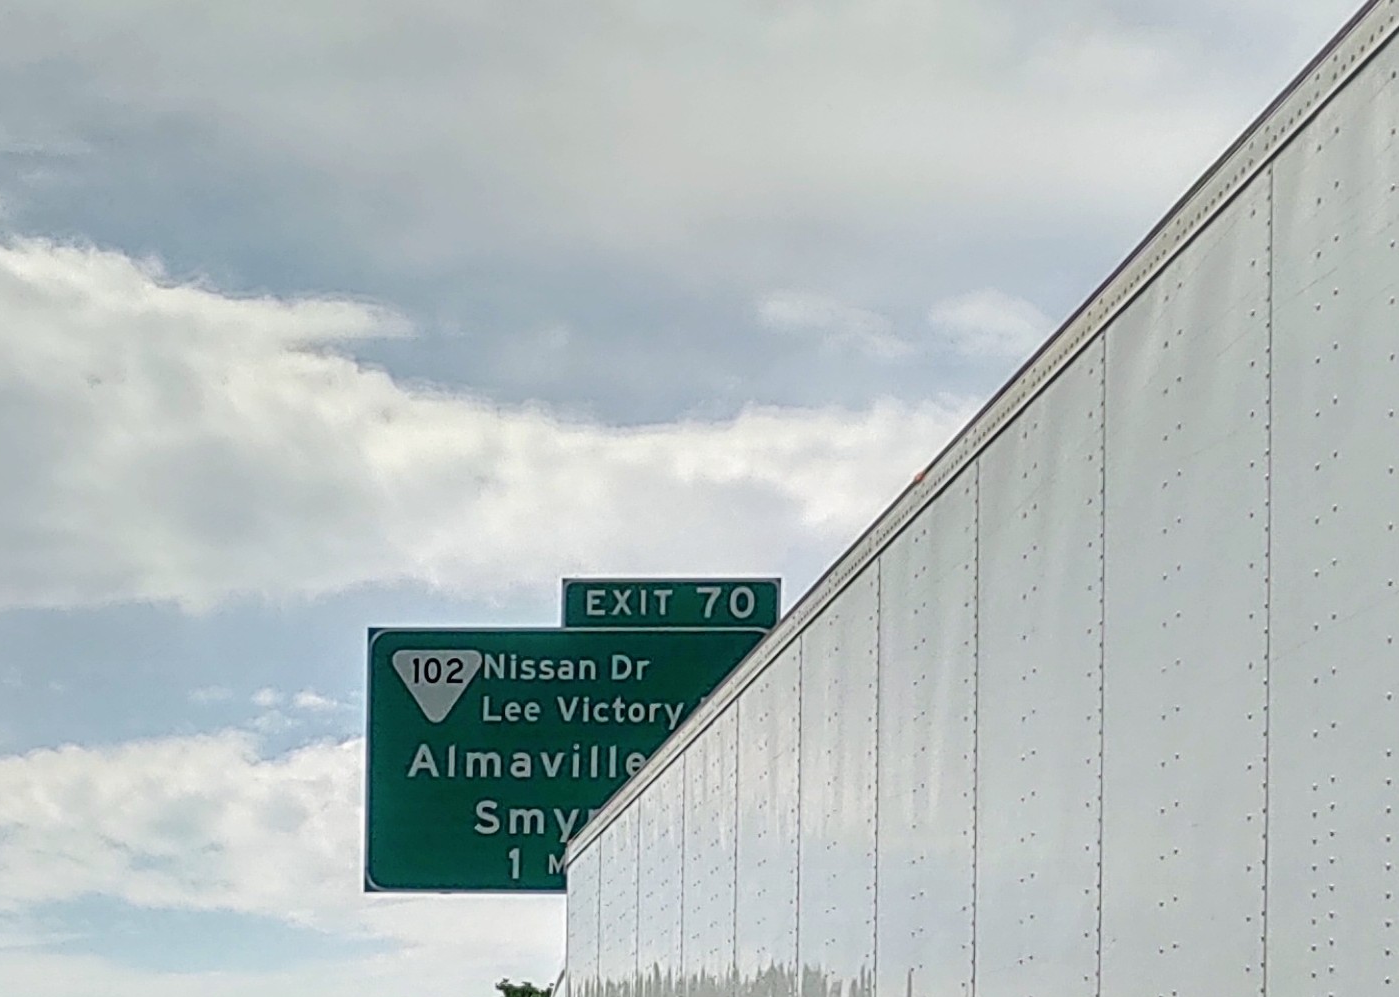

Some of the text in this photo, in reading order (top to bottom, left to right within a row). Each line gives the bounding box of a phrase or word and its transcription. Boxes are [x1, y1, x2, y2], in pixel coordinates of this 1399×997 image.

[586, 586, 755, 619] EXIT 70
[412, 657, 465, 684] 102
[484, 653, 651, 681] Nissan Dr
[482, 696, 685, 730] Lee Victory
[407, 743, 648, 778] Almaville
[508, 848, 520, 879] 1
